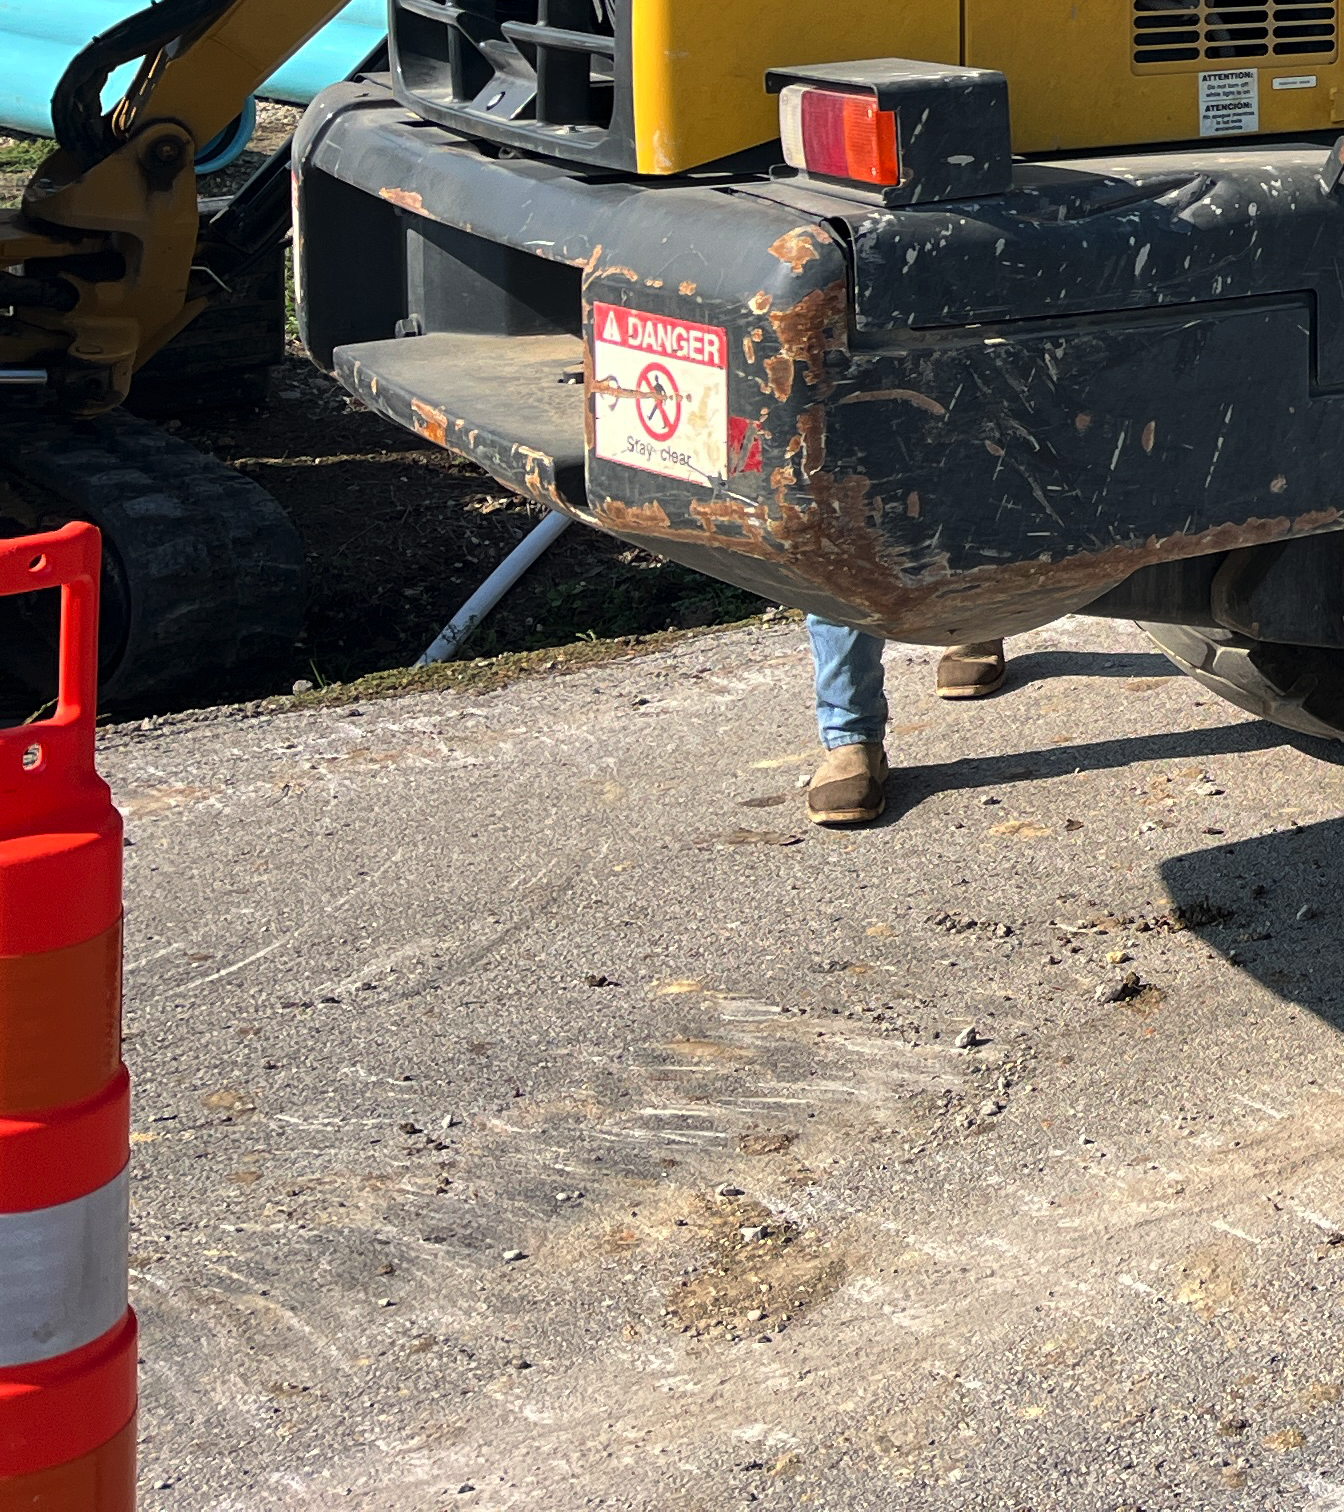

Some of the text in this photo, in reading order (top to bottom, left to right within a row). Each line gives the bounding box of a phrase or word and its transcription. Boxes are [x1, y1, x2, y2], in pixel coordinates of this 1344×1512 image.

[627, 316, 720, 364] DANGER
[627, 436, 692, 467] Stay clear
